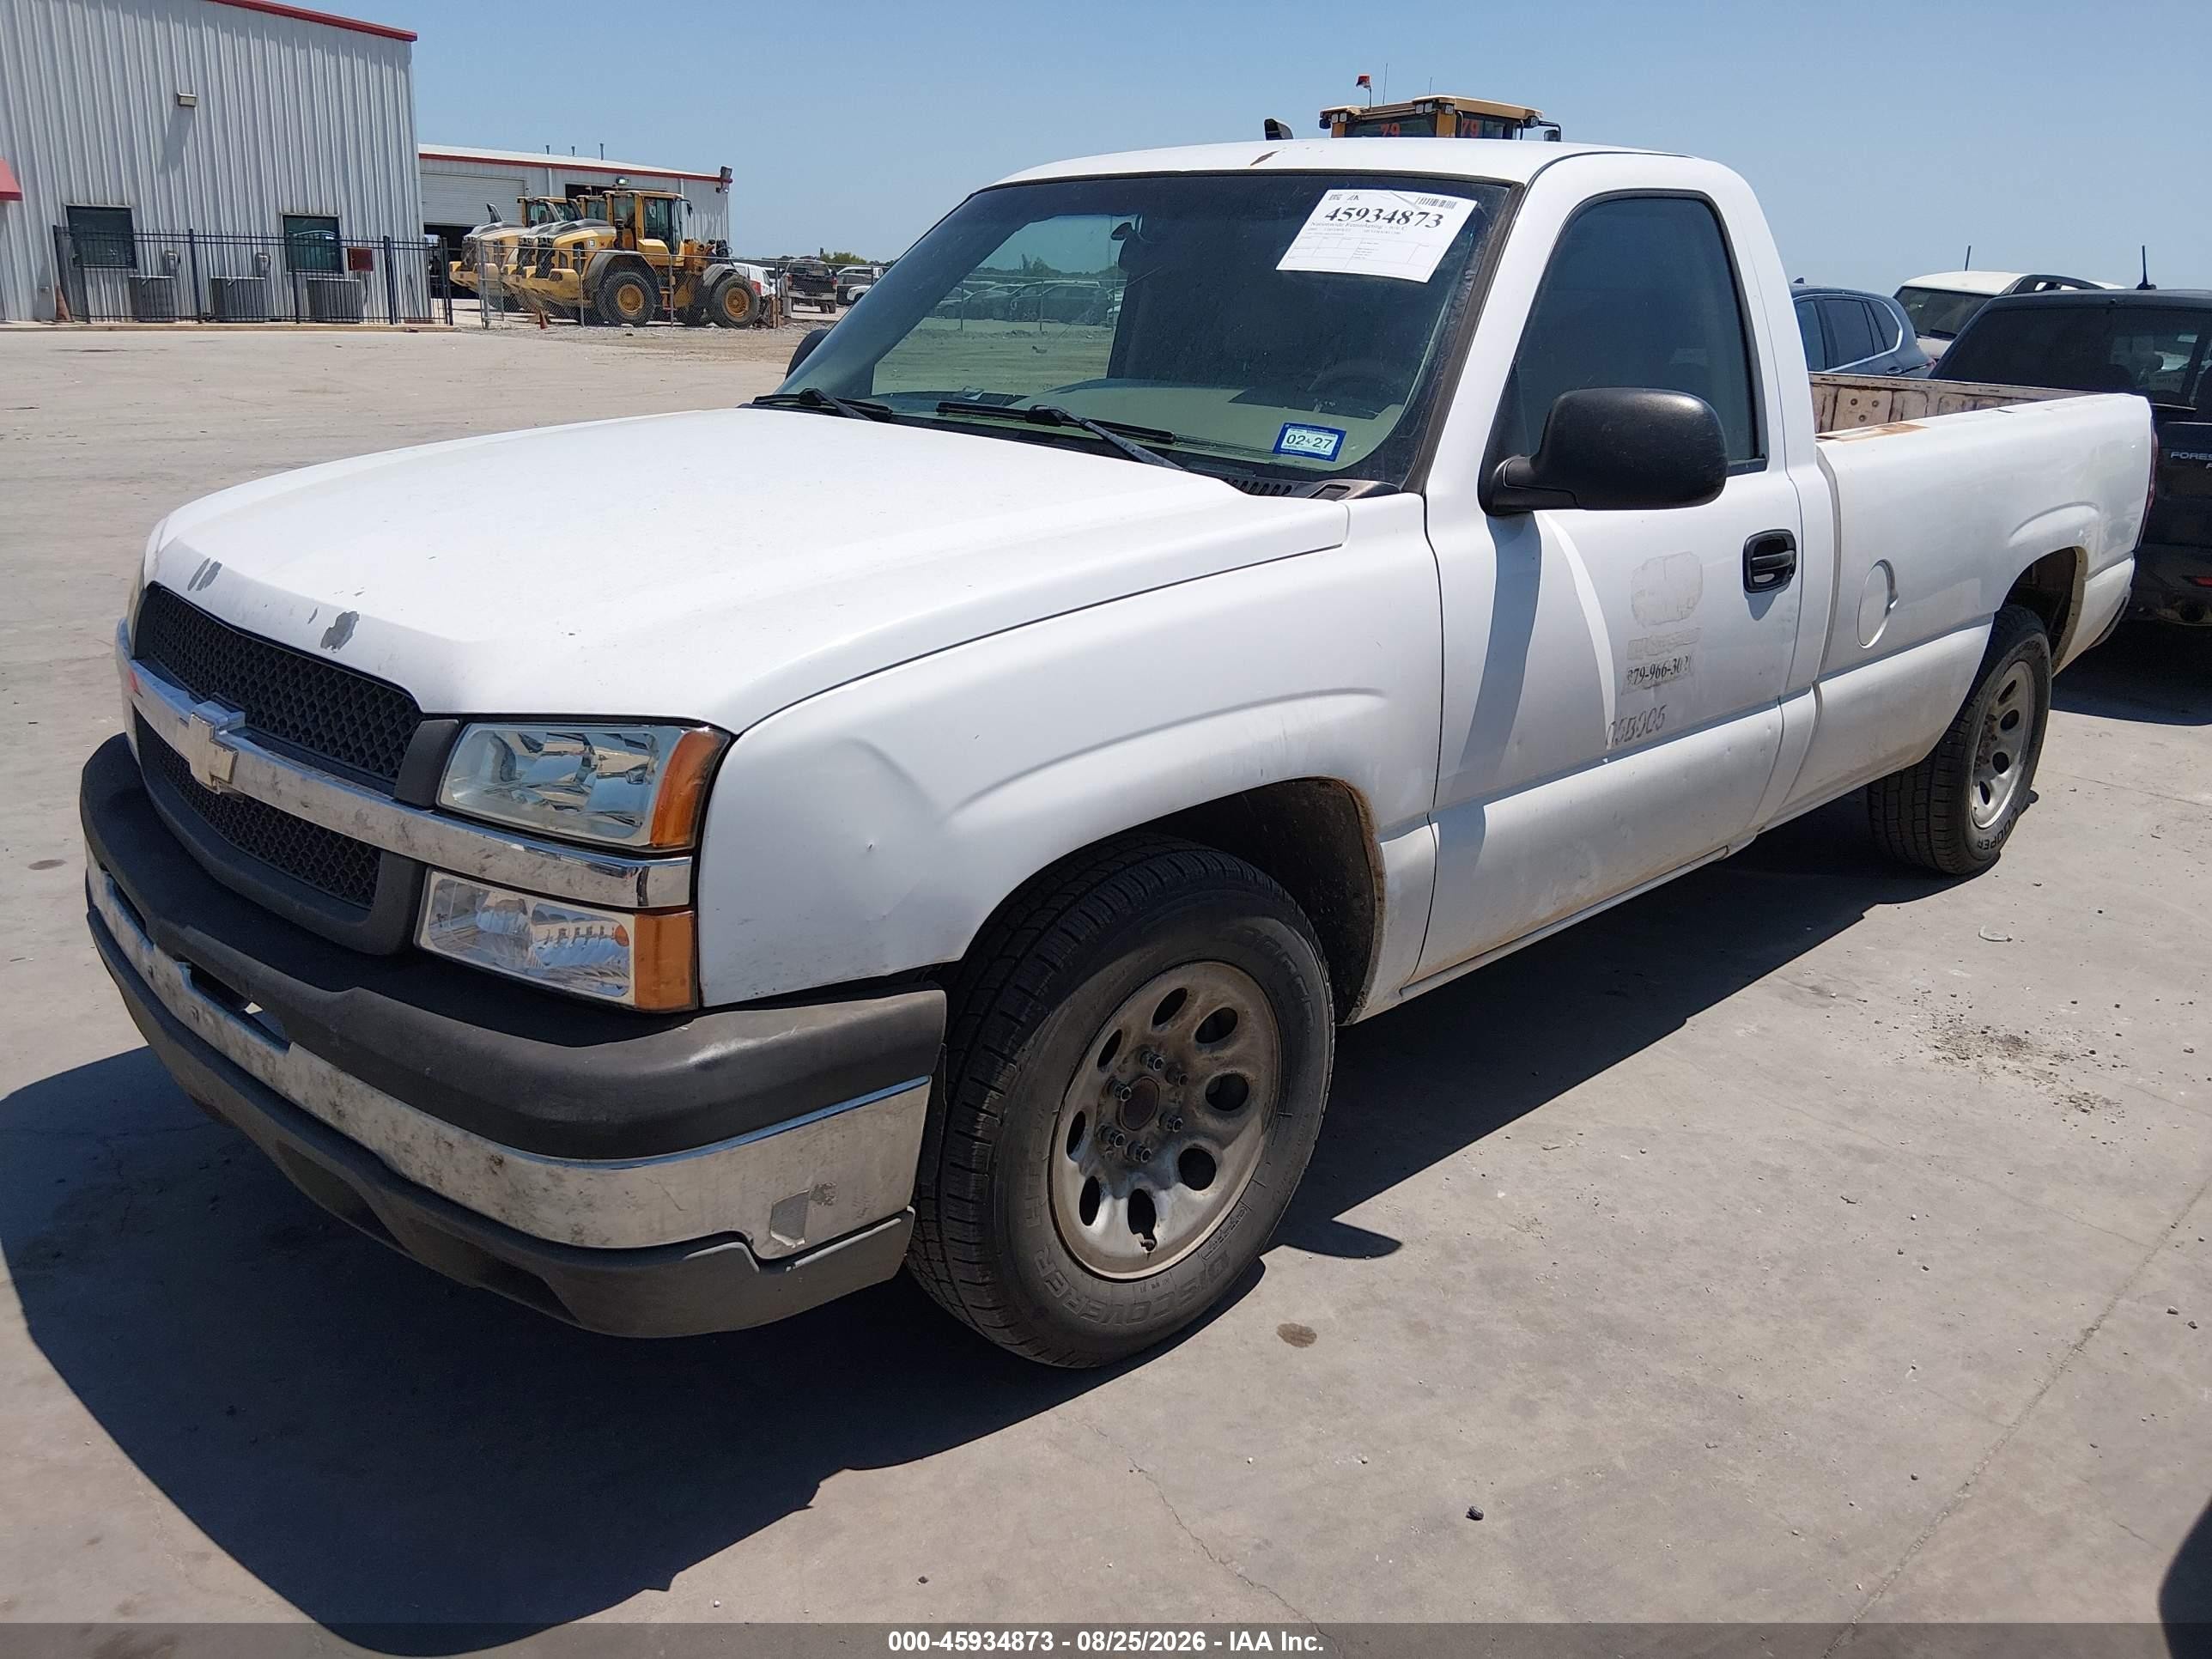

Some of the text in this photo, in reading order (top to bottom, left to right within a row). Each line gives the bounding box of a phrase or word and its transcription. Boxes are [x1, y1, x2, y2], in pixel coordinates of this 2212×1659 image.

[1325, 206, 1444, 228] 45934873
[1286, 434, 1306, 446] 02
[1312, 437, 1334, 449] 27
[1035, 1245, 1231, 1327] DISCOVERER
